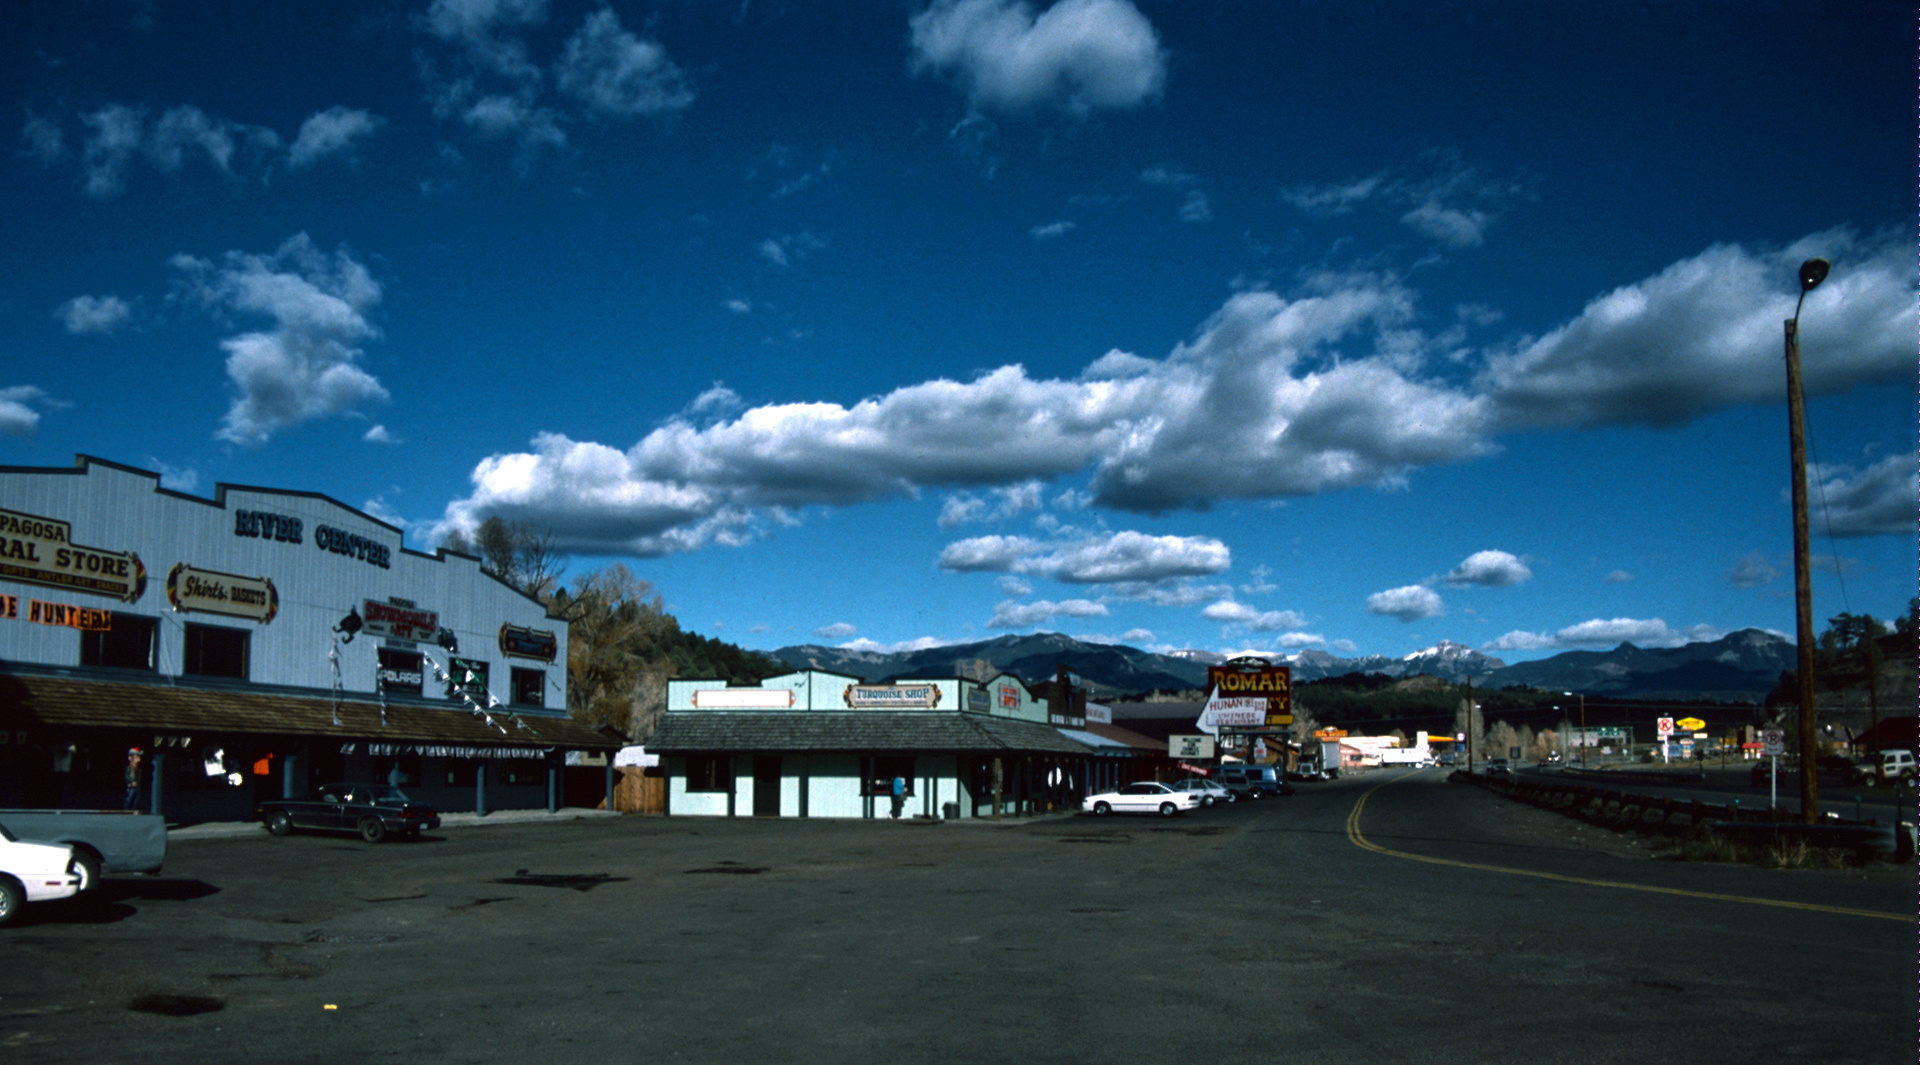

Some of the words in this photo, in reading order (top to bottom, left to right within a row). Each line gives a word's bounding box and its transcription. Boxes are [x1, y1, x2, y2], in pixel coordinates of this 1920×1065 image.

[0, 514, 66, 543] PAGOSA
[235, 509, 303, 543] RIVER
[315, 523, 390, 569] CENTER
[56, 548, 128, 577] STORE
[37, 571, 72, 585] ANTLER
[74, 577, 91, 587] ART
[231, 586, 266, 605] BASKETS
[30, 600, 110, 629] HUNTERS
[365, 601, 437, 633] SNOWMOBILE
[380, 669, 421, 685] POLARIS
[1213, 670, 1287, 692] ROMAR
[856, 689, 902, 699] TURQUOISE
[905, 688, 930, 699] SHOP
[1209, 697, 1243, 712] HUNAN
